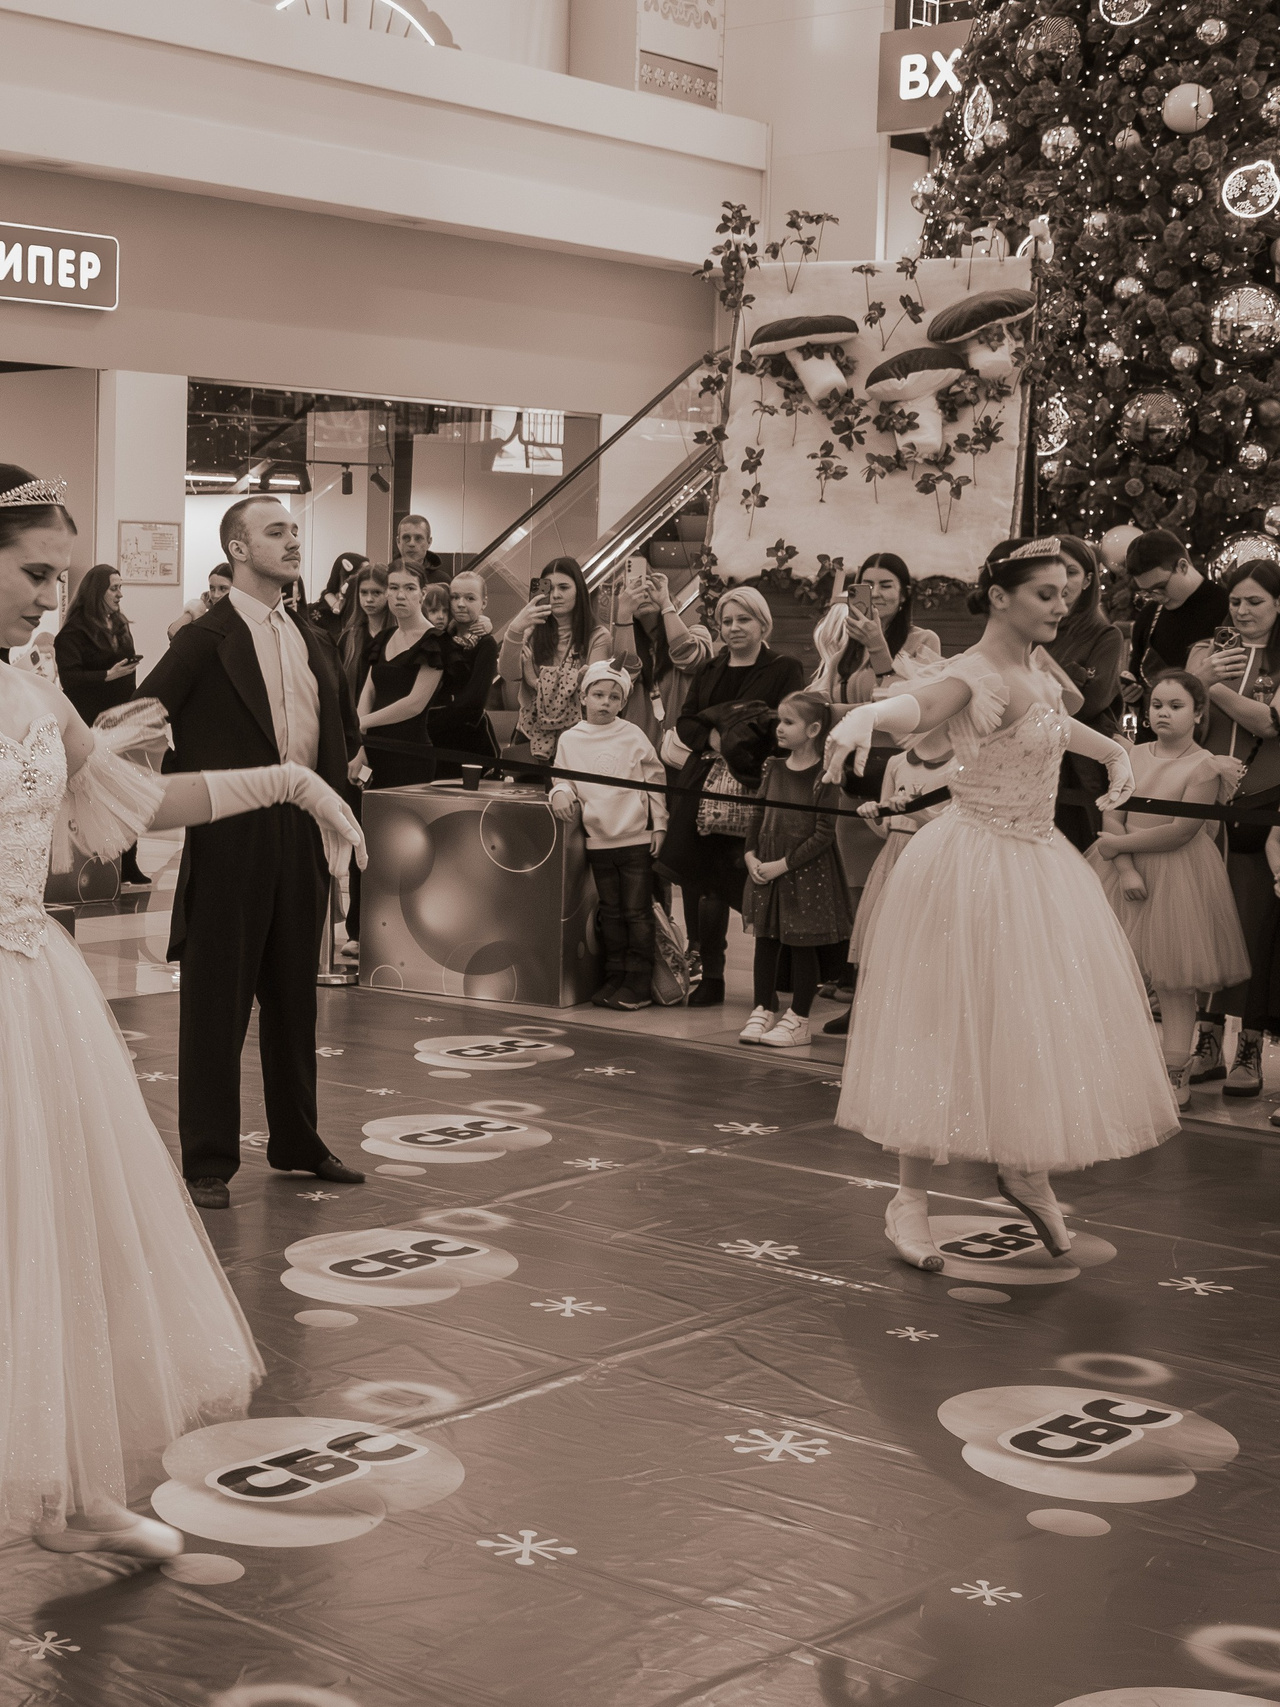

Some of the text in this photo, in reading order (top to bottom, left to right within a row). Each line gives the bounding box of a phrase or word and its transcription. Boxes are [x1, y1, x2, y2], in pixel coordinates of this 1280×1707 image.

[445, 1040, 548, 1058] СБС
[398, 1120, 521, 1146] СБС
[328, 1239, 482, 1280] СБС
[1008, 1398, 1174, 1459] СБС
[216, 1431, 418, 1498] СБС
